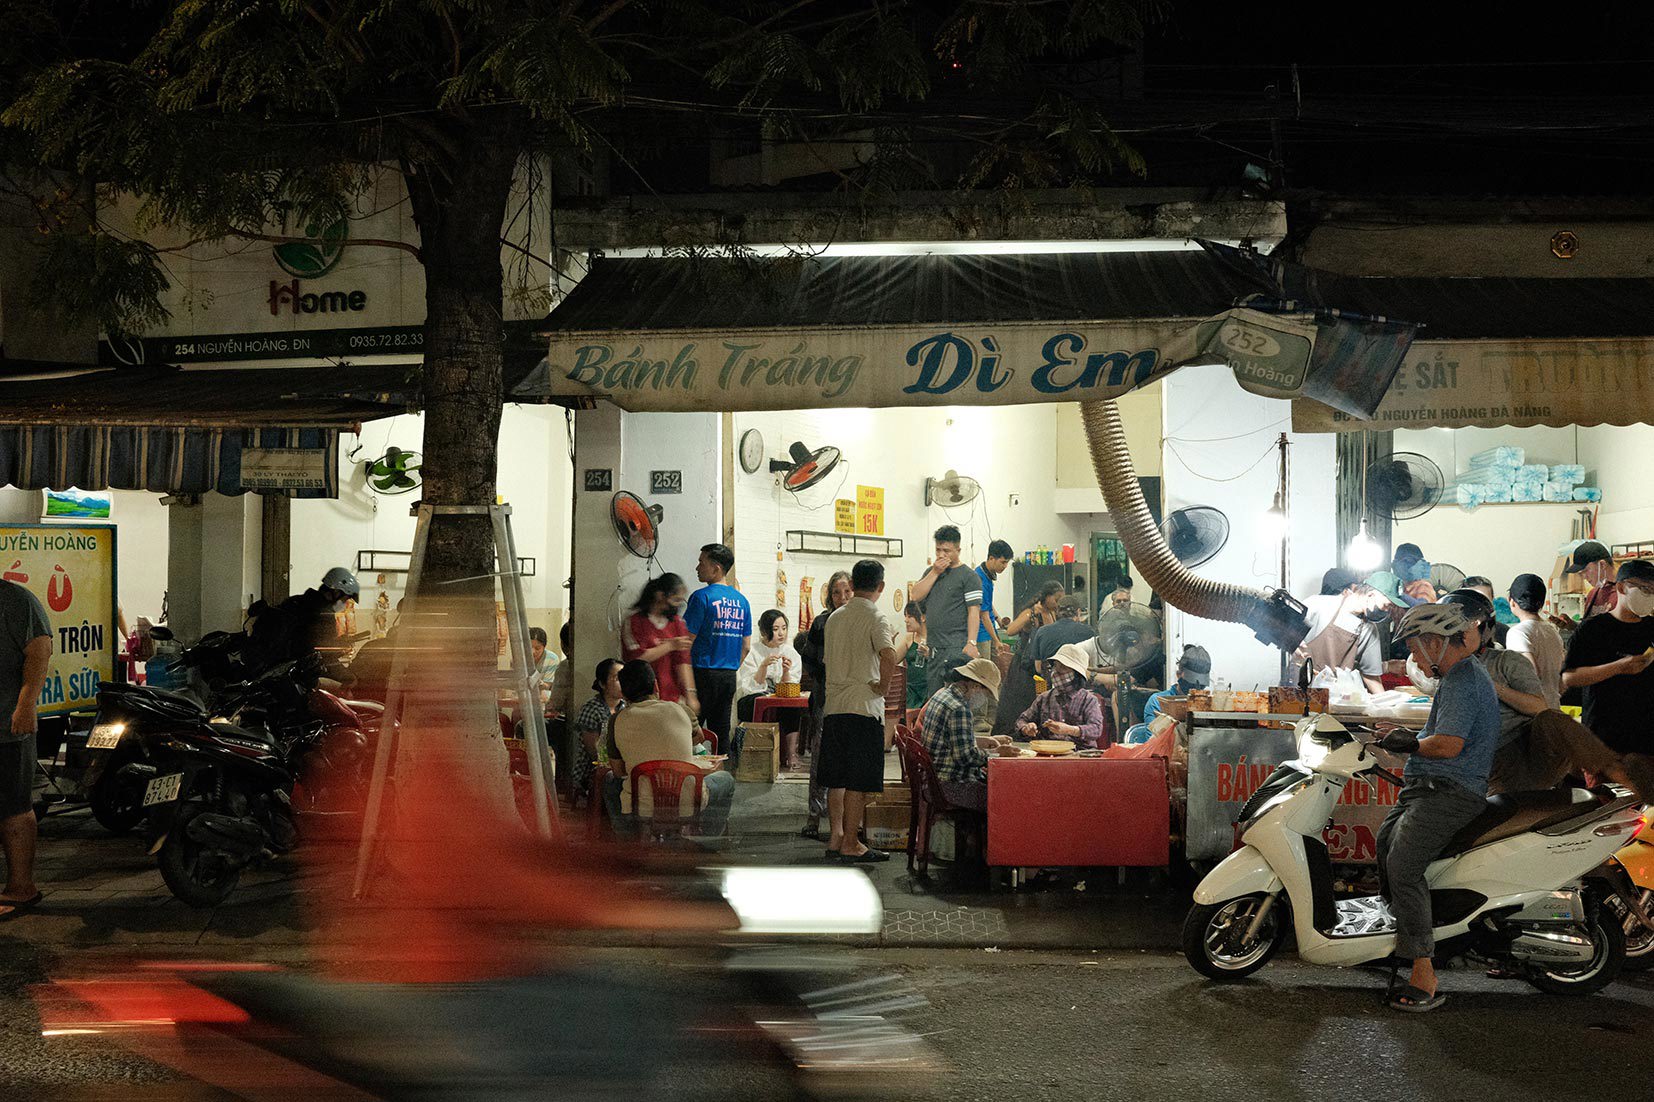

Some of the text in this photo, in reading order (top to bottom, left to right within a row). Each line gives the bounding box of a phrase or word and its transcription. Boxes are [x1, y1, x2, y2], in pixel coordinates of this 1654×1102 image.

[267, 278, 367, 316] Home
[175, 344, 195, 356] 254
[292, 338, 311, 350] ĐN
[350, 333, 424, 349] 0935.72.82.33
[1226, 327, 1267, 355] 252
[566, 332, 1166, 399] Bánh Tráng Dì Em
[1243, 359, 1296, 388] Hoàng
[587, 472, 610, 487] 254
[654, 472, 680, 488] 252
[862, 514, 878, 533] 15K
[44, 533, 97, 551] HOÀNG
[722, 596, 741, 608] FULL
[58, 620, 104, 658] TRỘN
[36, 667, 101, 706] RÀ SỮA
[1216, 754, 1276, 803] BÁN
